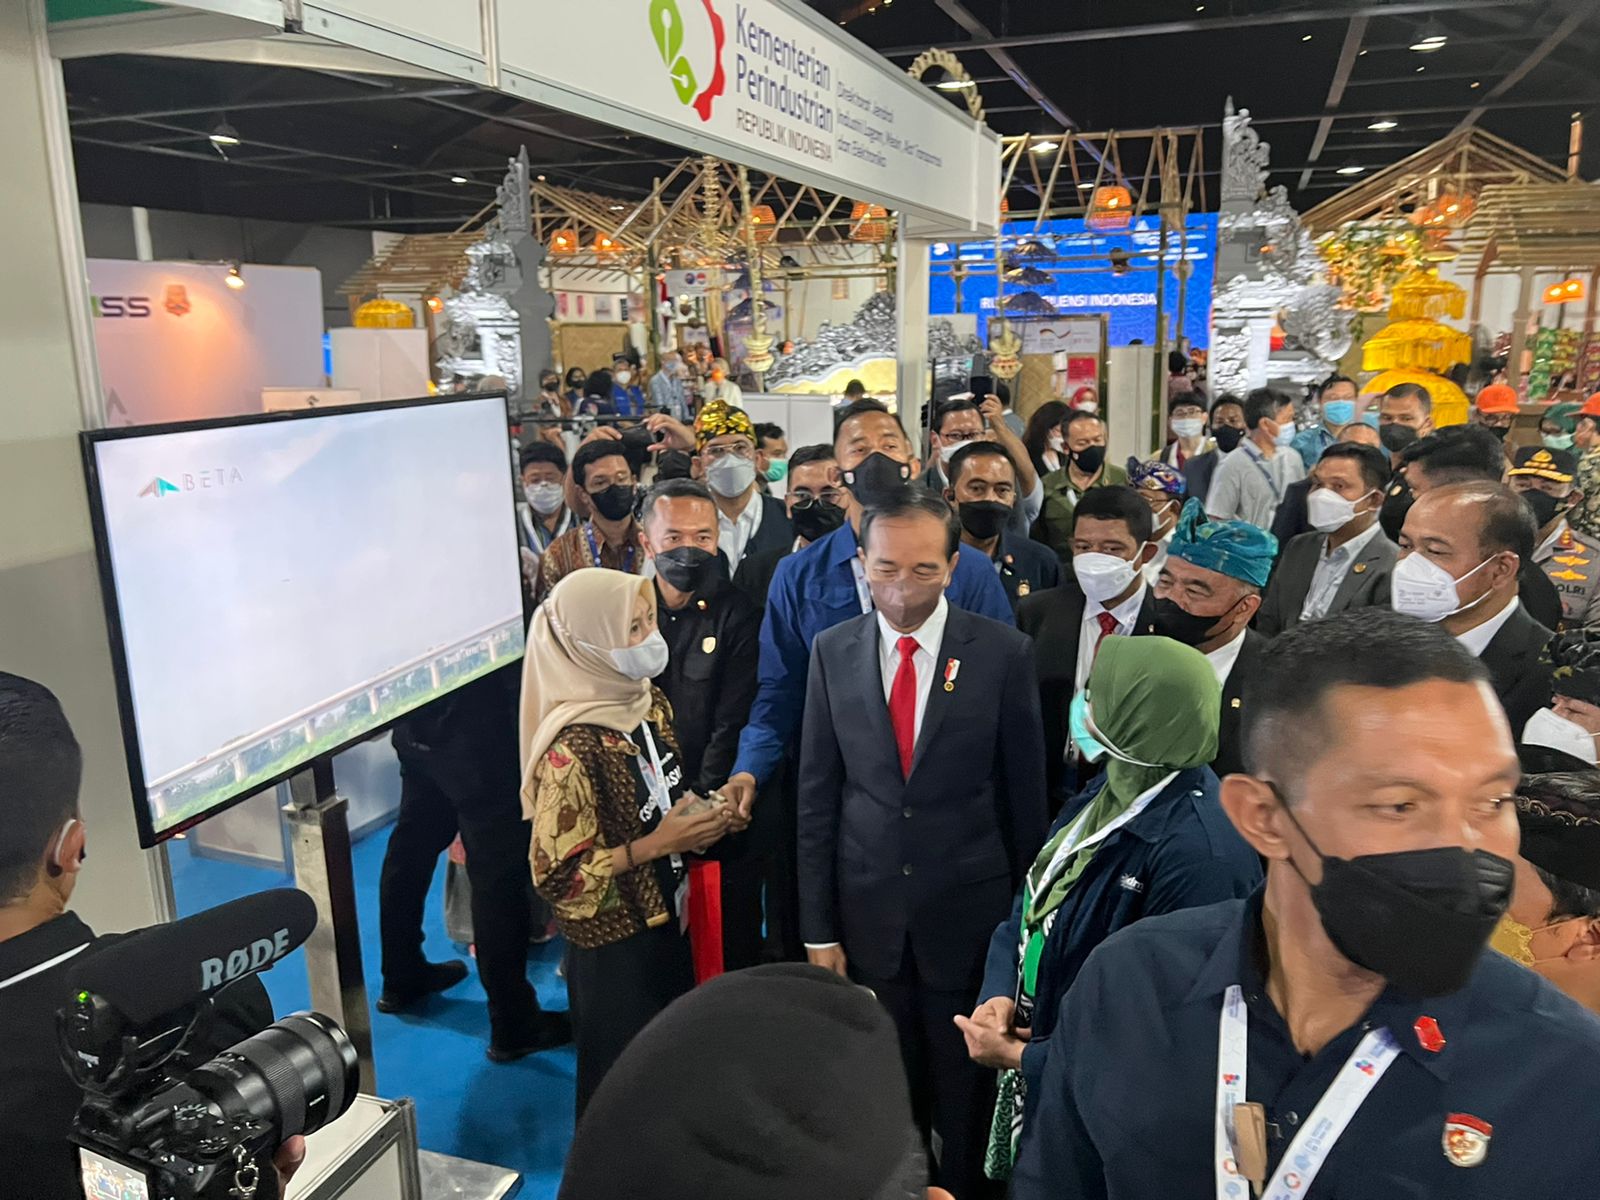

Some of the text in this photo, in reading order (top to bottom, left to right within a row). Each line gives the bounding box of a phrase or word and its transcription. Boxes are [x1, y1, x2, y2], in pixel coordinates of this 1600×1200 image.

[736, 3, 830, 90] Kementerian
[736, 53, 834, 133] Perindustrian
[737, 107, 833, 162] REPUBLIK INDONESIA
[1090, 292, 1157, 306] INDONESIA
[184, 467, 243, 491] BETA
[1555, 583, 1586, 595] OLRI
[201, 928, 289, 991] RØDE
